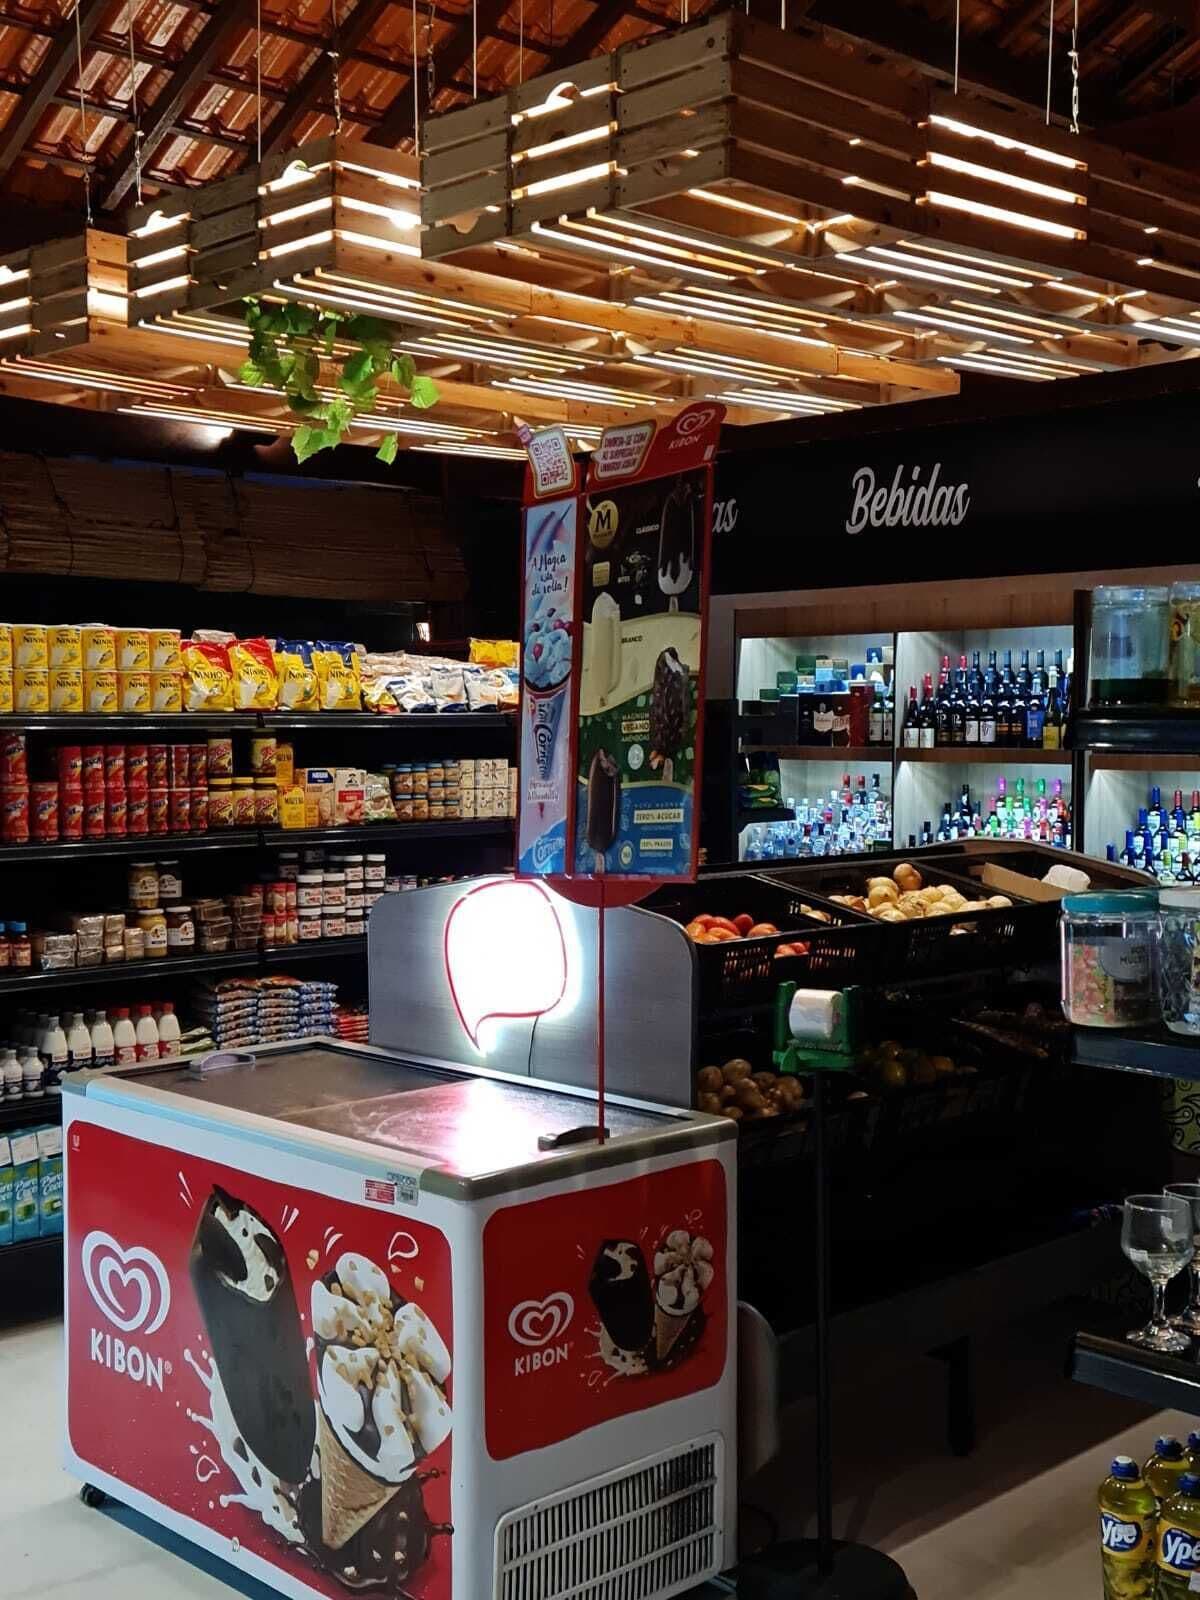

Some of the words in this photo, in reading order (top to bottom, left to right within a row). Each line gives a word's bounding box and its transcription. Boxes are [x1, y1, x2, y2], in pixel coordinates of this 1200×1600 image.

[668, 434, 702, 449] KIBON
[846, 462, 970, 534] Bebidas
[623, 722, 649, 732] VEGANO
[514, 1344, 569, 1376] KIBON
